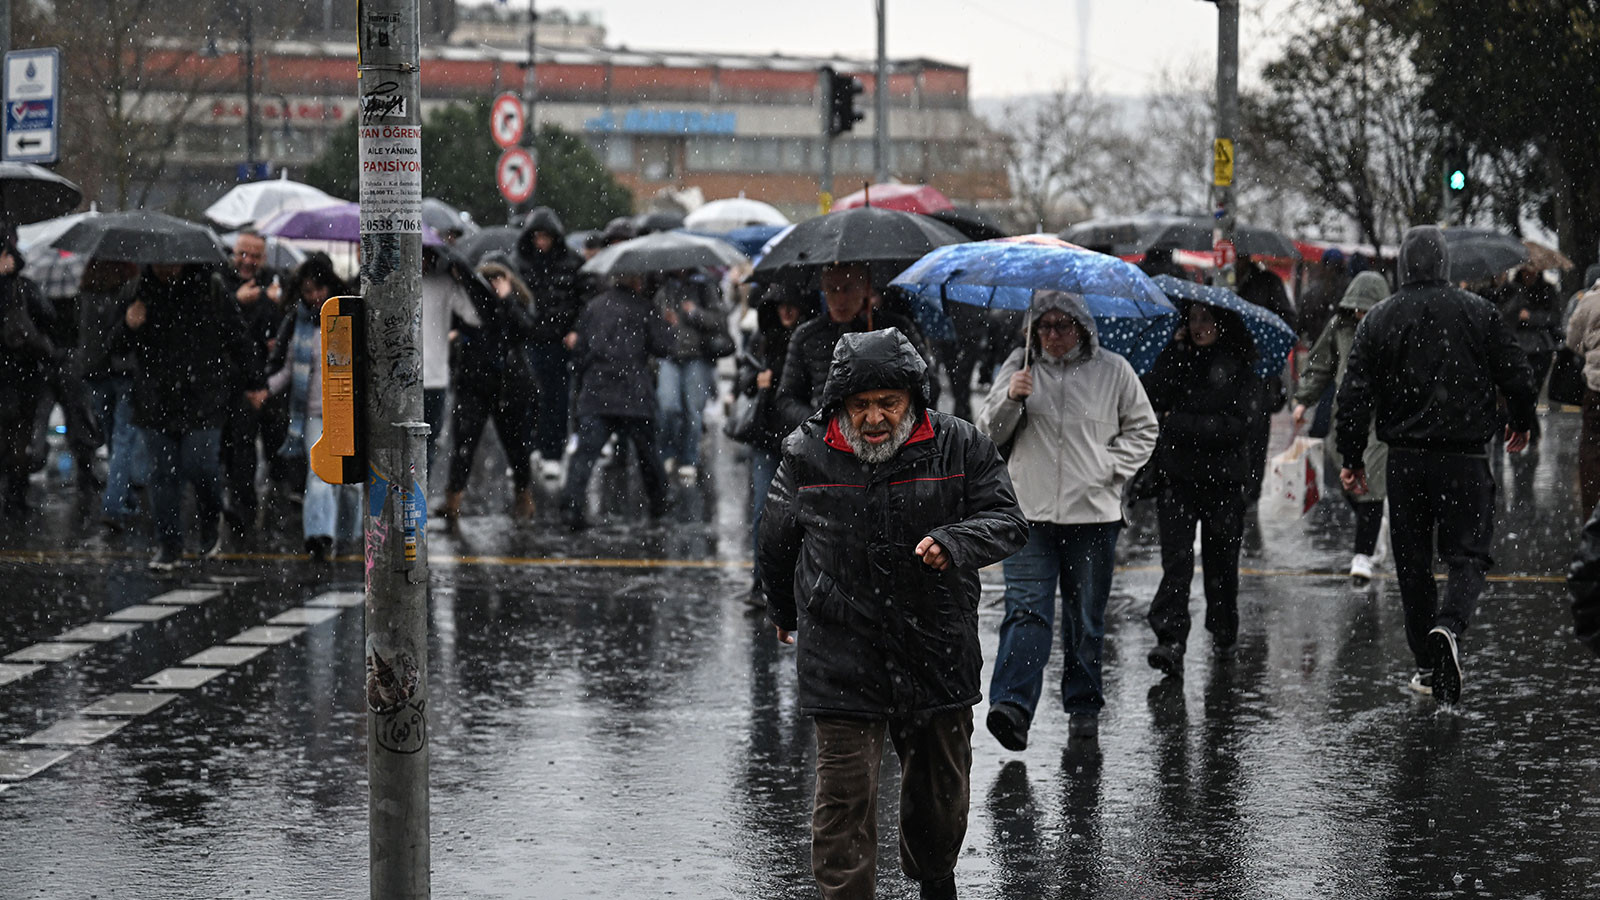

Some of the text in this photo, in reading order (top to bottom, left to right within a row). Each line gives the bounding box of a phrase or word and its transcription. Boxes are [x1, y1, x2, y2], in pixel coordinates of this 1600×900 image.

[385, 147, 417, 155] YANINDA
[363, 159, 420, 172] PANSİYON
[366, 219, 393, 231] 0538
[397, 219, 416, 231] 706
